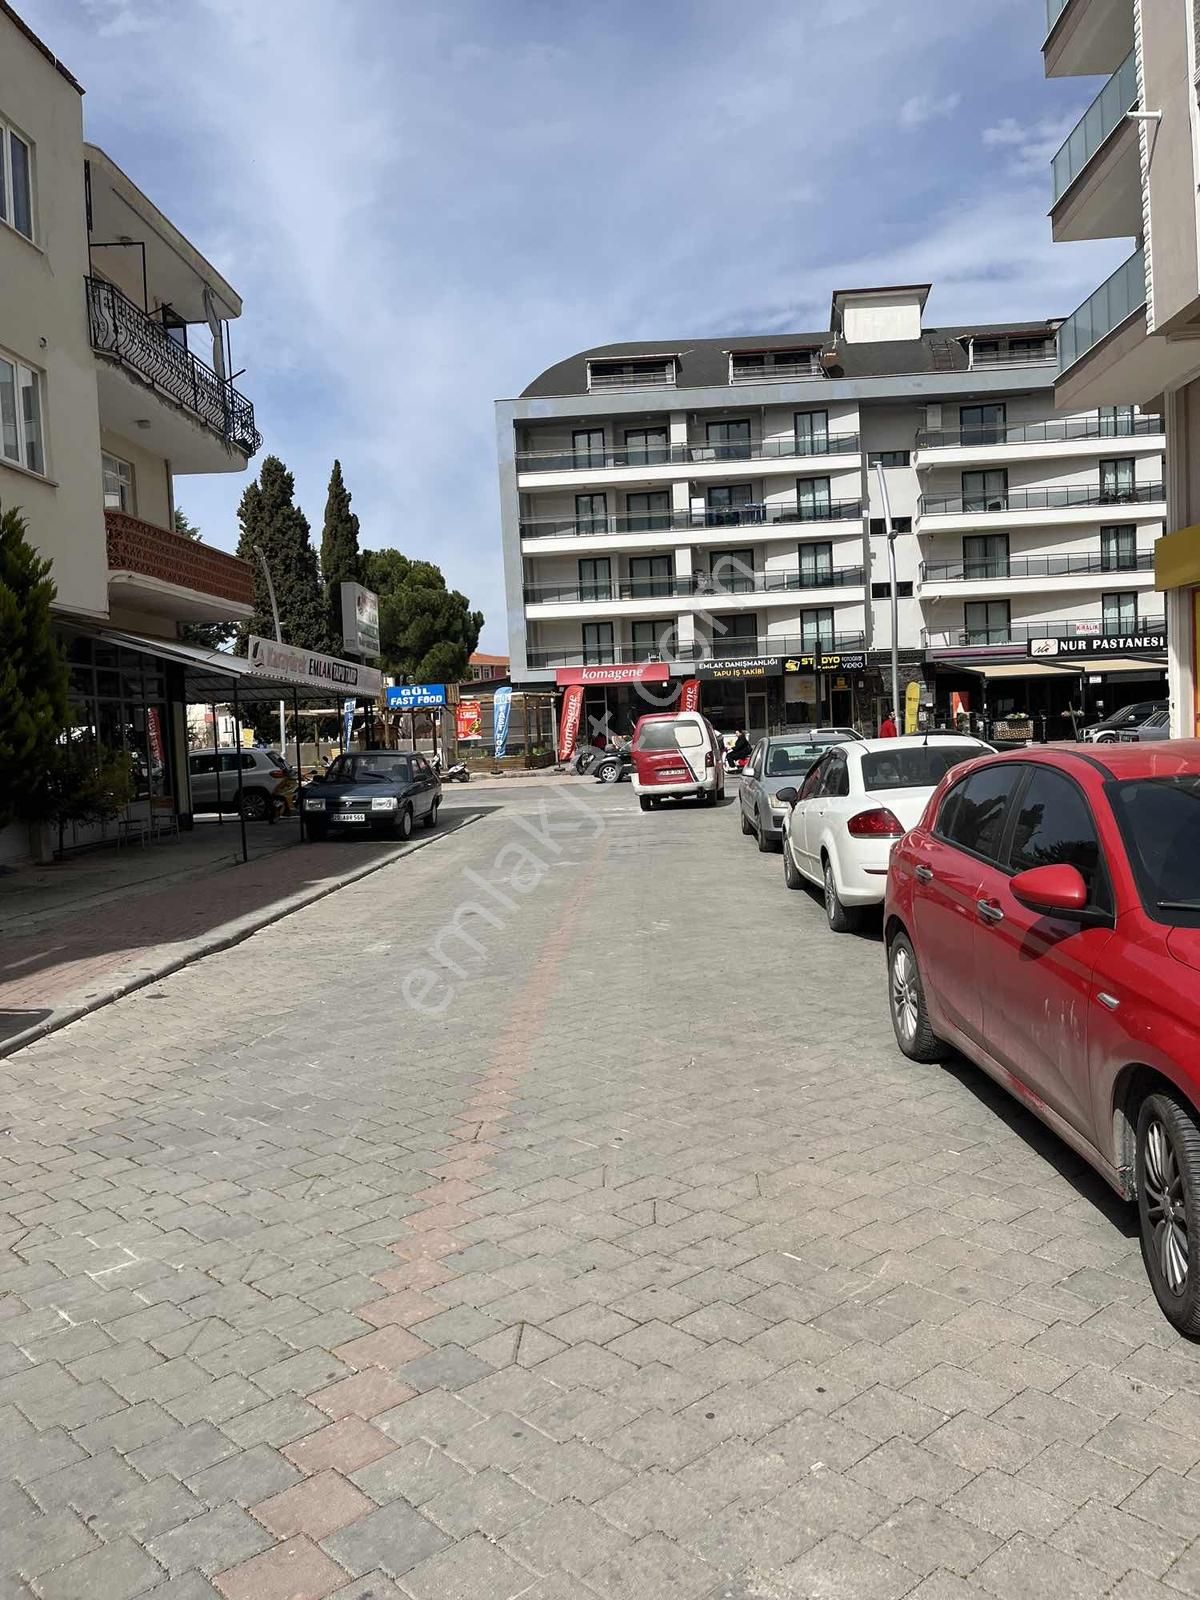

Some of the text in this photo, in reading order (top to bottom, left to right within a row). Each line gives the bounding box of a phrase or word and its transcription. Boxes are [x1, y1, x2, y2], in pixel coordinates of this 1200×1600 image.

[1060, 641, 1086, 651] NUR
[801, 656, 840, 665] STDYO
[309, 659, 332, 679] EMLAK
[699, 662, 724, 670] EMLAK
[582, 668, 644, 680] komagene
[401, 686, 431, 696] GÜL
[390, 695, 443, 706] FAST FOOD
[561, 694, 577, 754] komagene
